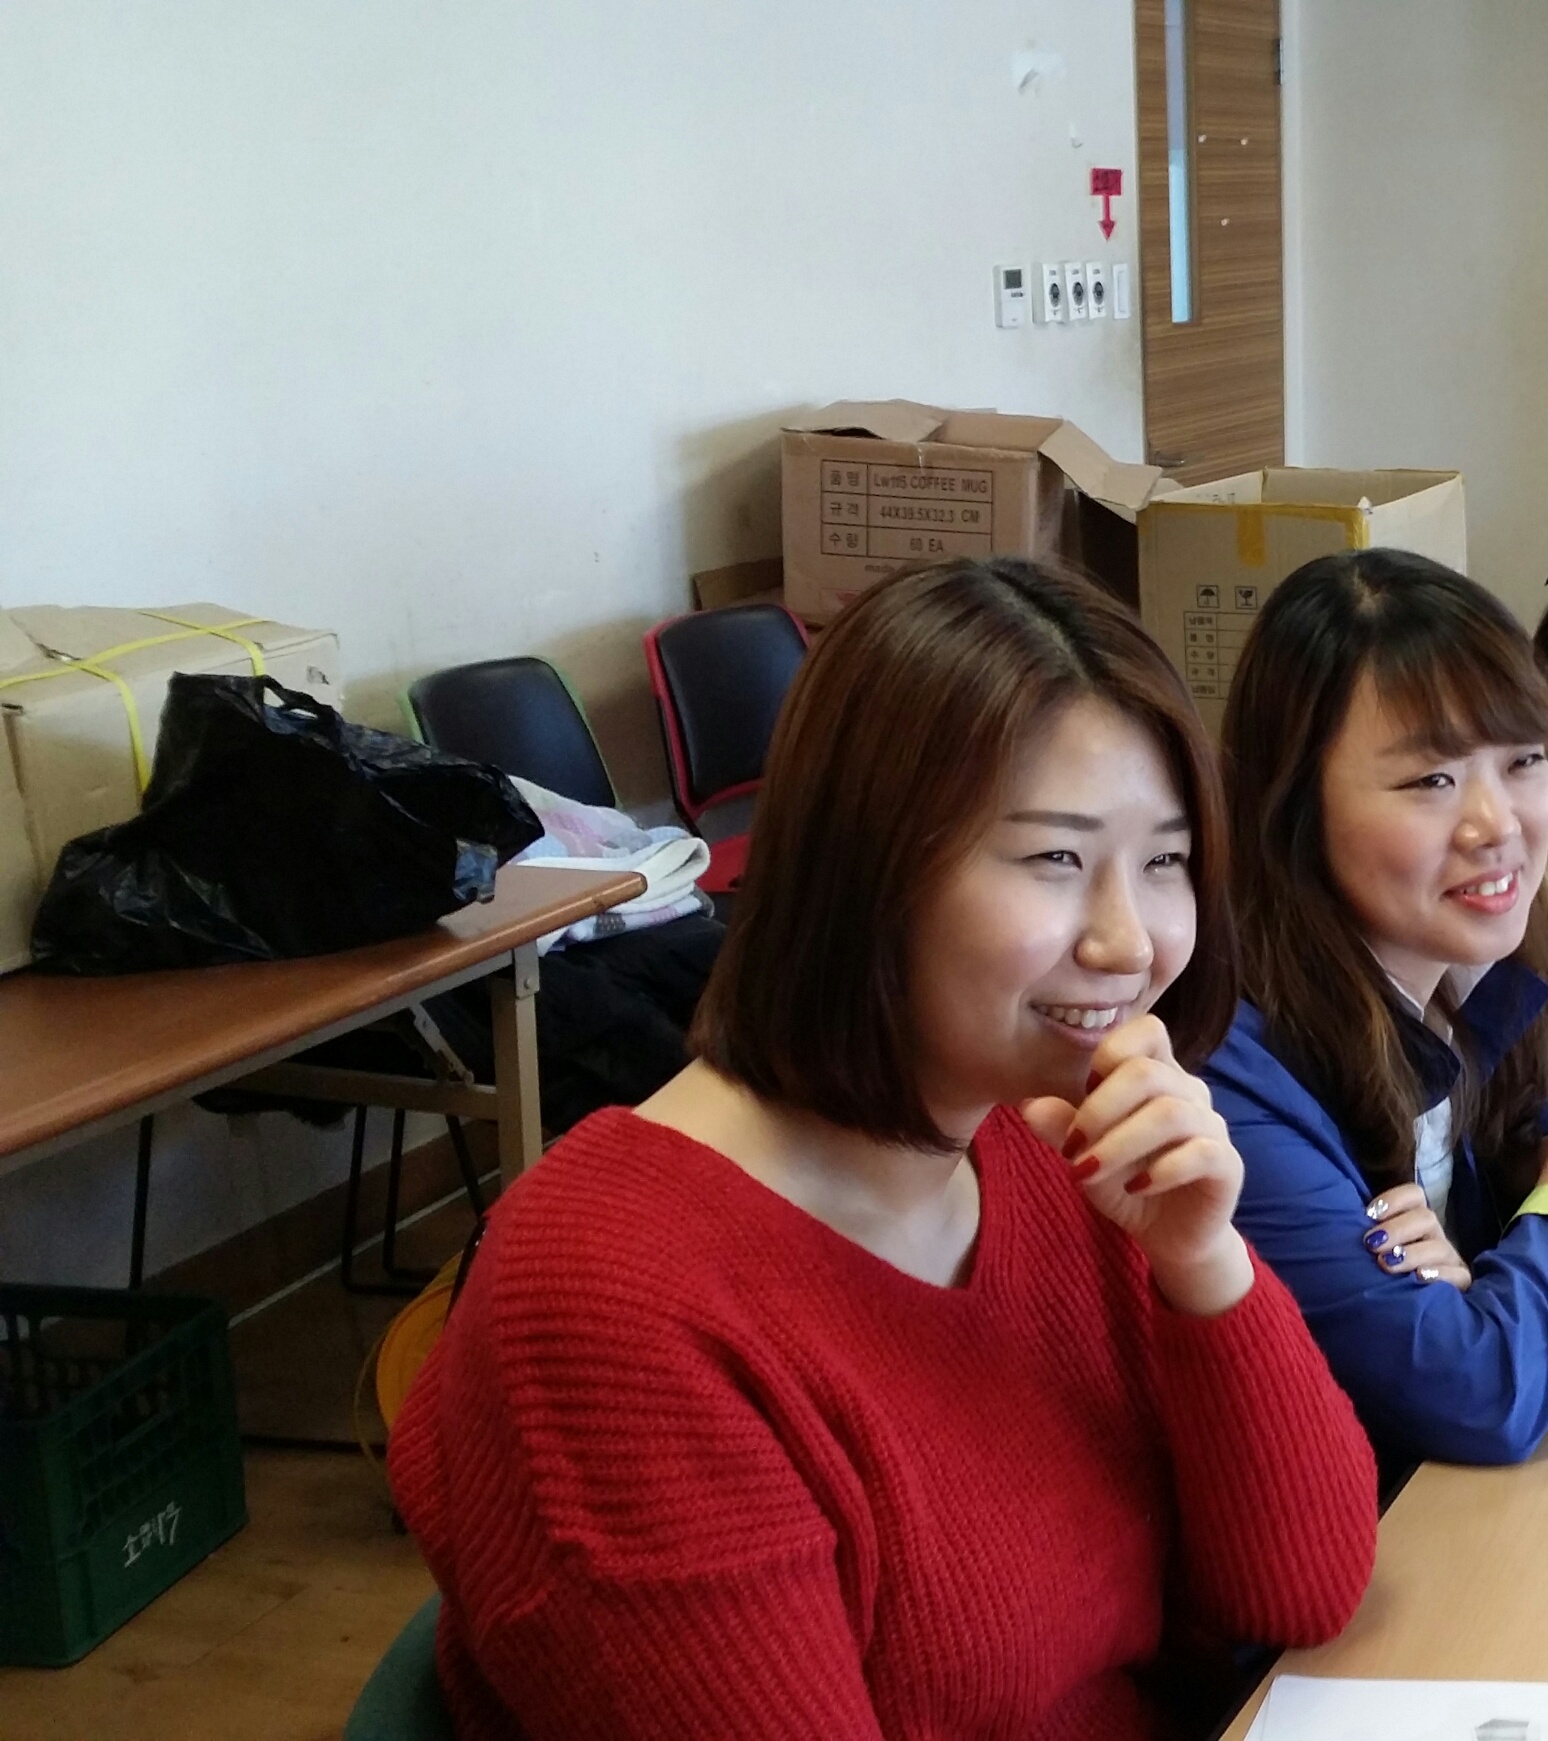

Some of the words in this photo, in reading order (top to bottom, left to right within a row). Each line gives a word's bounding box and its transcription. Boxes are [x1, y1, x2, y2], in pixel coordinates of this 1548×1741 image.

[909, 474, 956, 491] COFFEE
[960, 477, 987, 493] MUG
[961, 508, 979, 522] CM
[928, 538, 944, 553] EA
